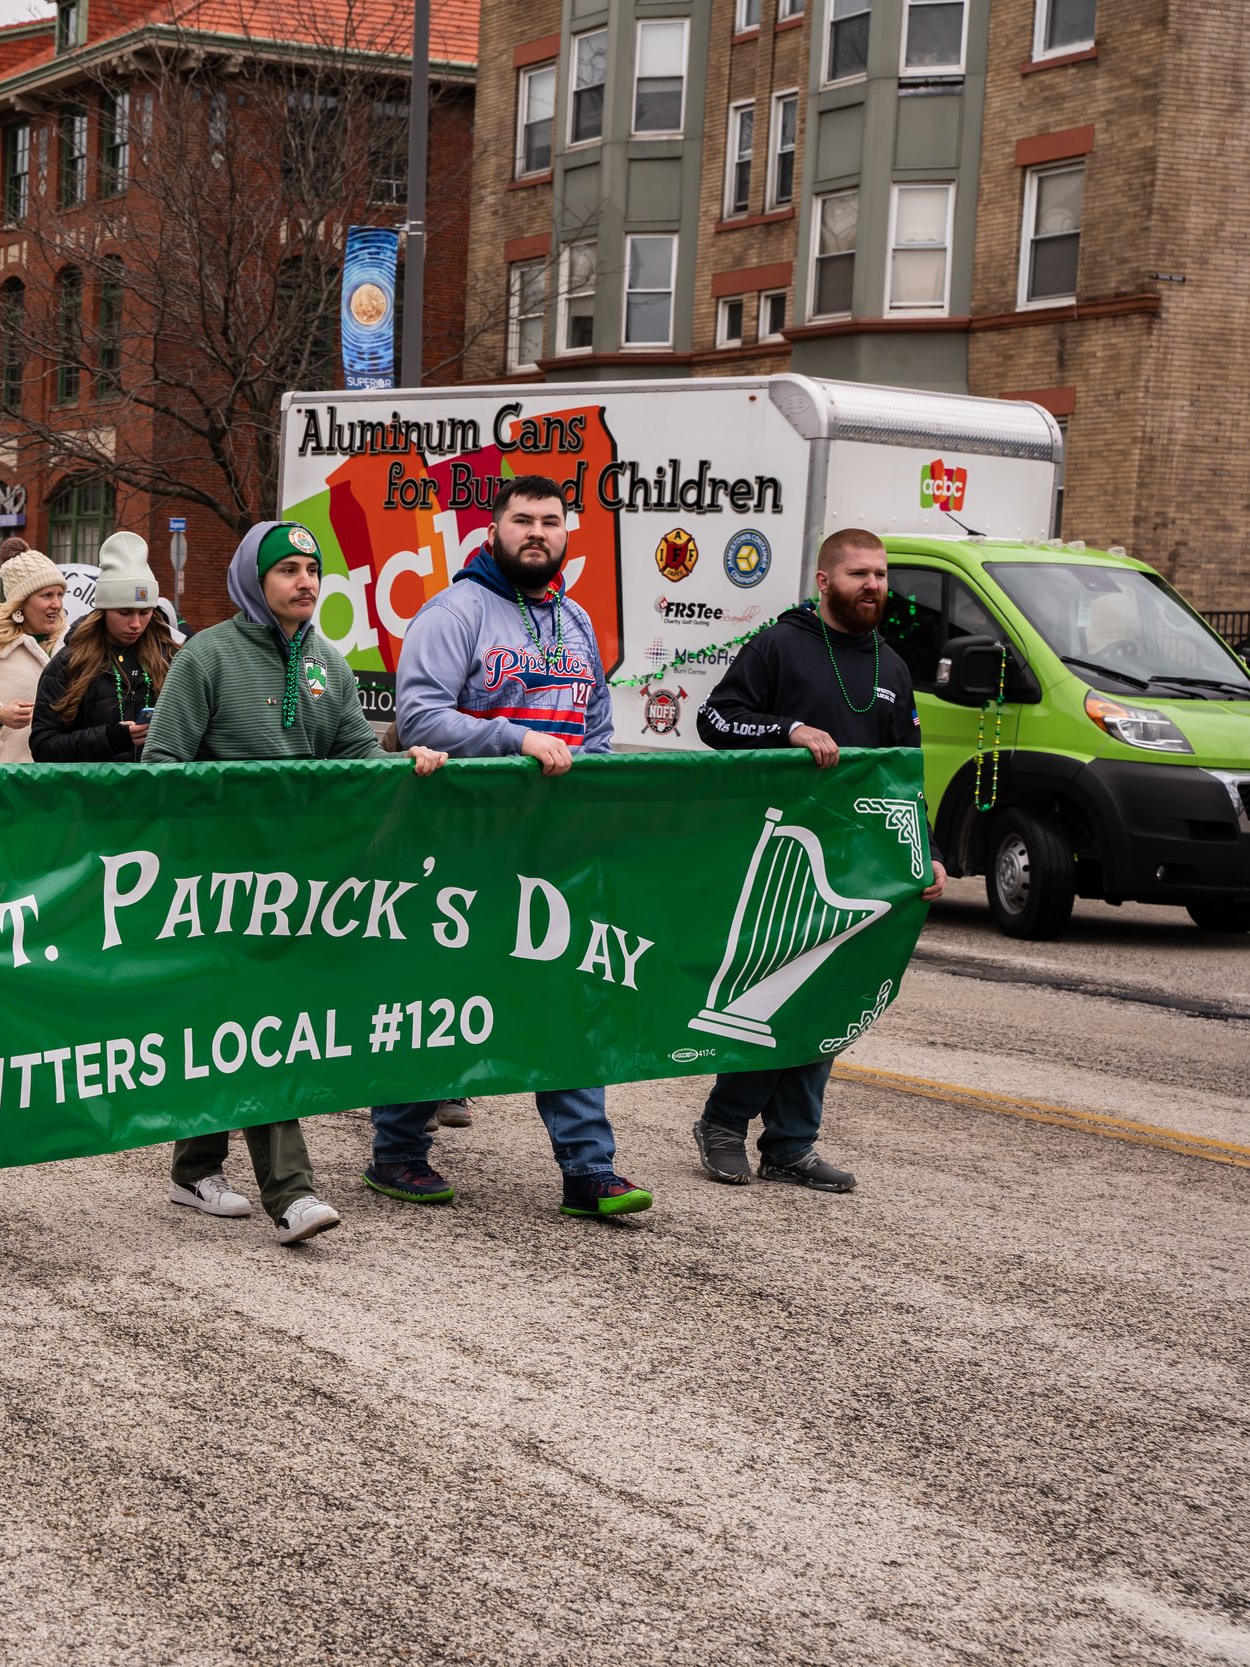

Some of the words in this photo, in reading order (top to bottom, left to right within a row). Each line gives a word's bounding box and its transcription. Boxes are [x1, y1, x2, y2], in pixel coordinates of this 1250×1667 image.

[298, 405, 481, 457] Aluminum
[493, 402, 585, 451] Cans
[383, 461, 438, 510] for
[597, 458, 784, 514] Children
[922, 475, 963, 497] acbc
[649, 705, 676, 719] NOFF
[99, 850, 478, 951] PATRICK'S
[509, 873, 655, 991] DAY
[183, 1008, 352, 1081] LOCAL
[368, 995, 494, 1054] #120
[698, 1048, 716, 1058] 417-C
